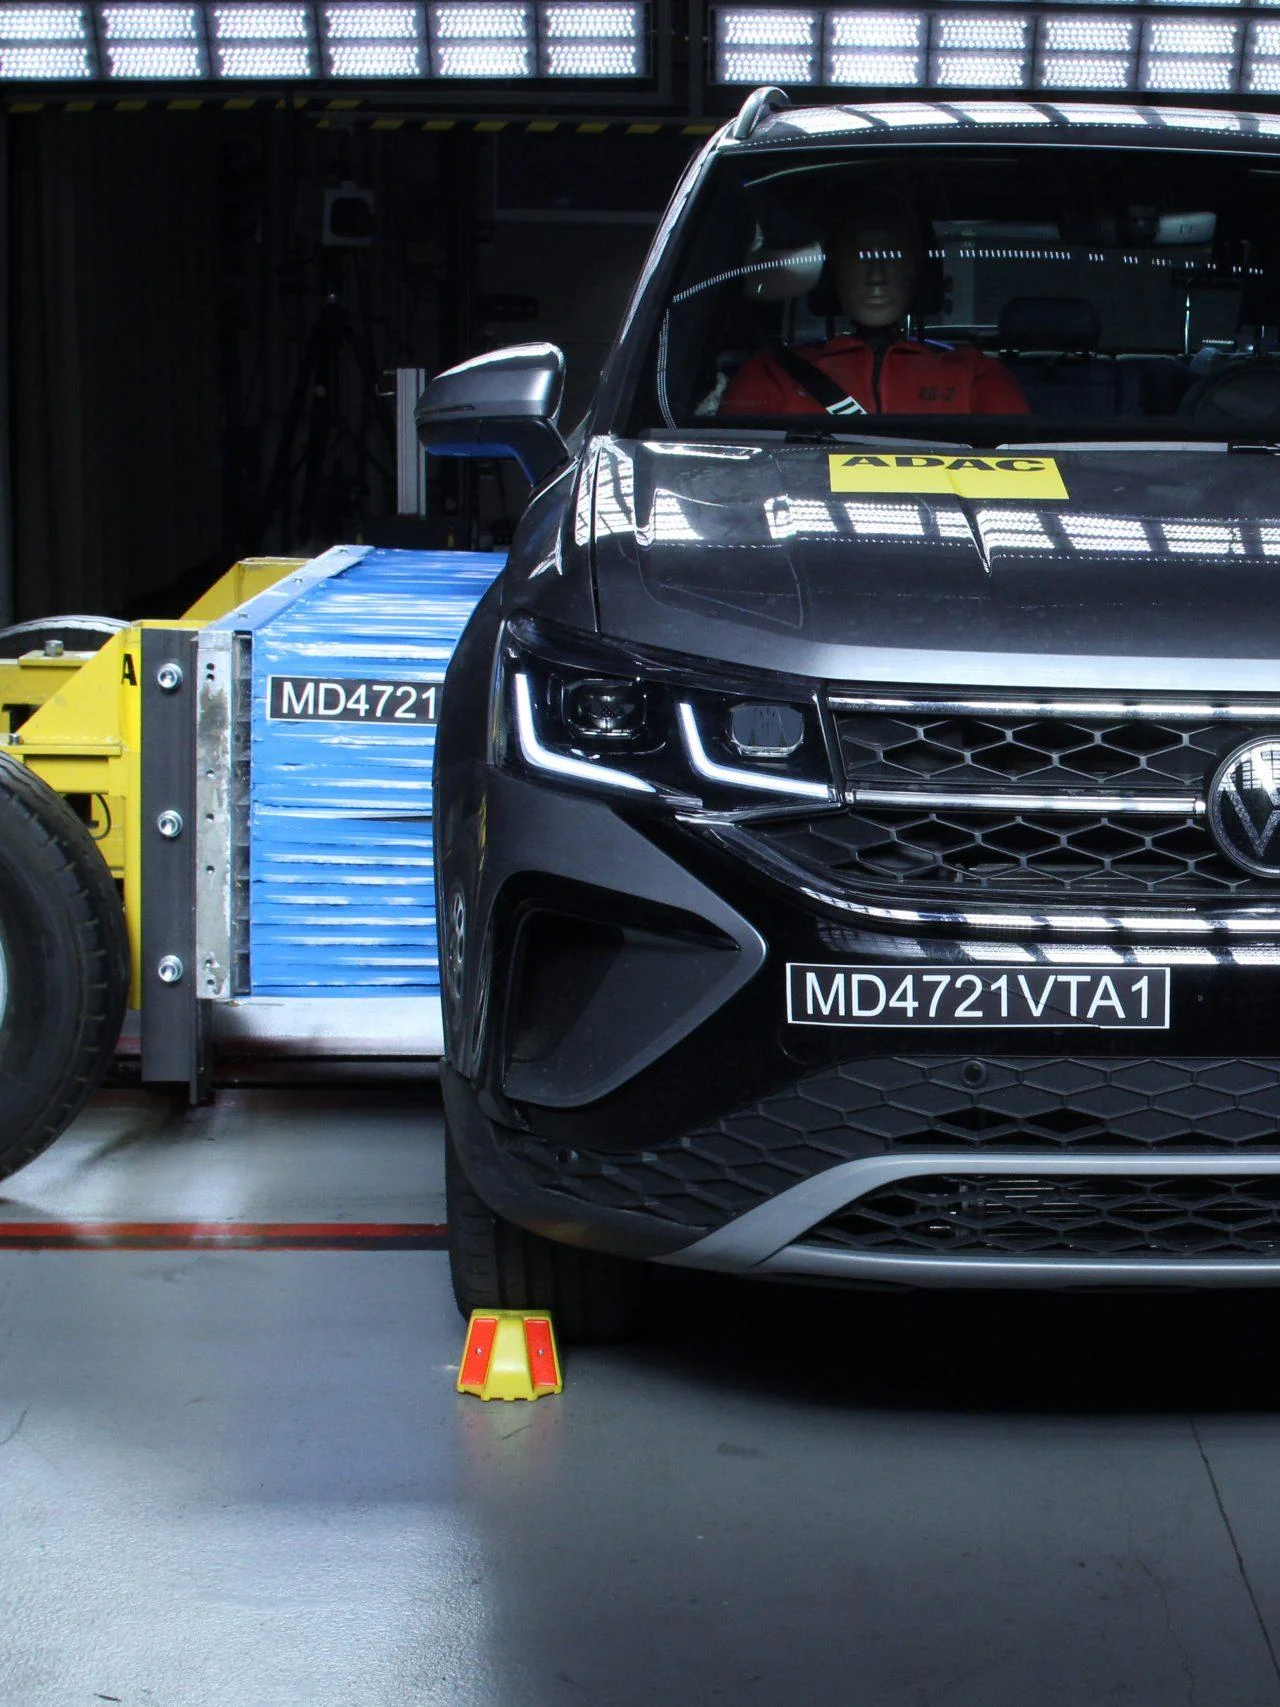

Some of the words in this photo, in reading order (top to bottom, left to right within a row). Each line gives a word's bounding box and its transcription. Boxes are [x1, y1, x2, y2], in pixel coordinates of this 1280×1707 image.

[841, 456, 1046, 472] ADAC
[121, 653, 137, 686] A
[805, 972, 1150, 1019] MD4721VTA1
